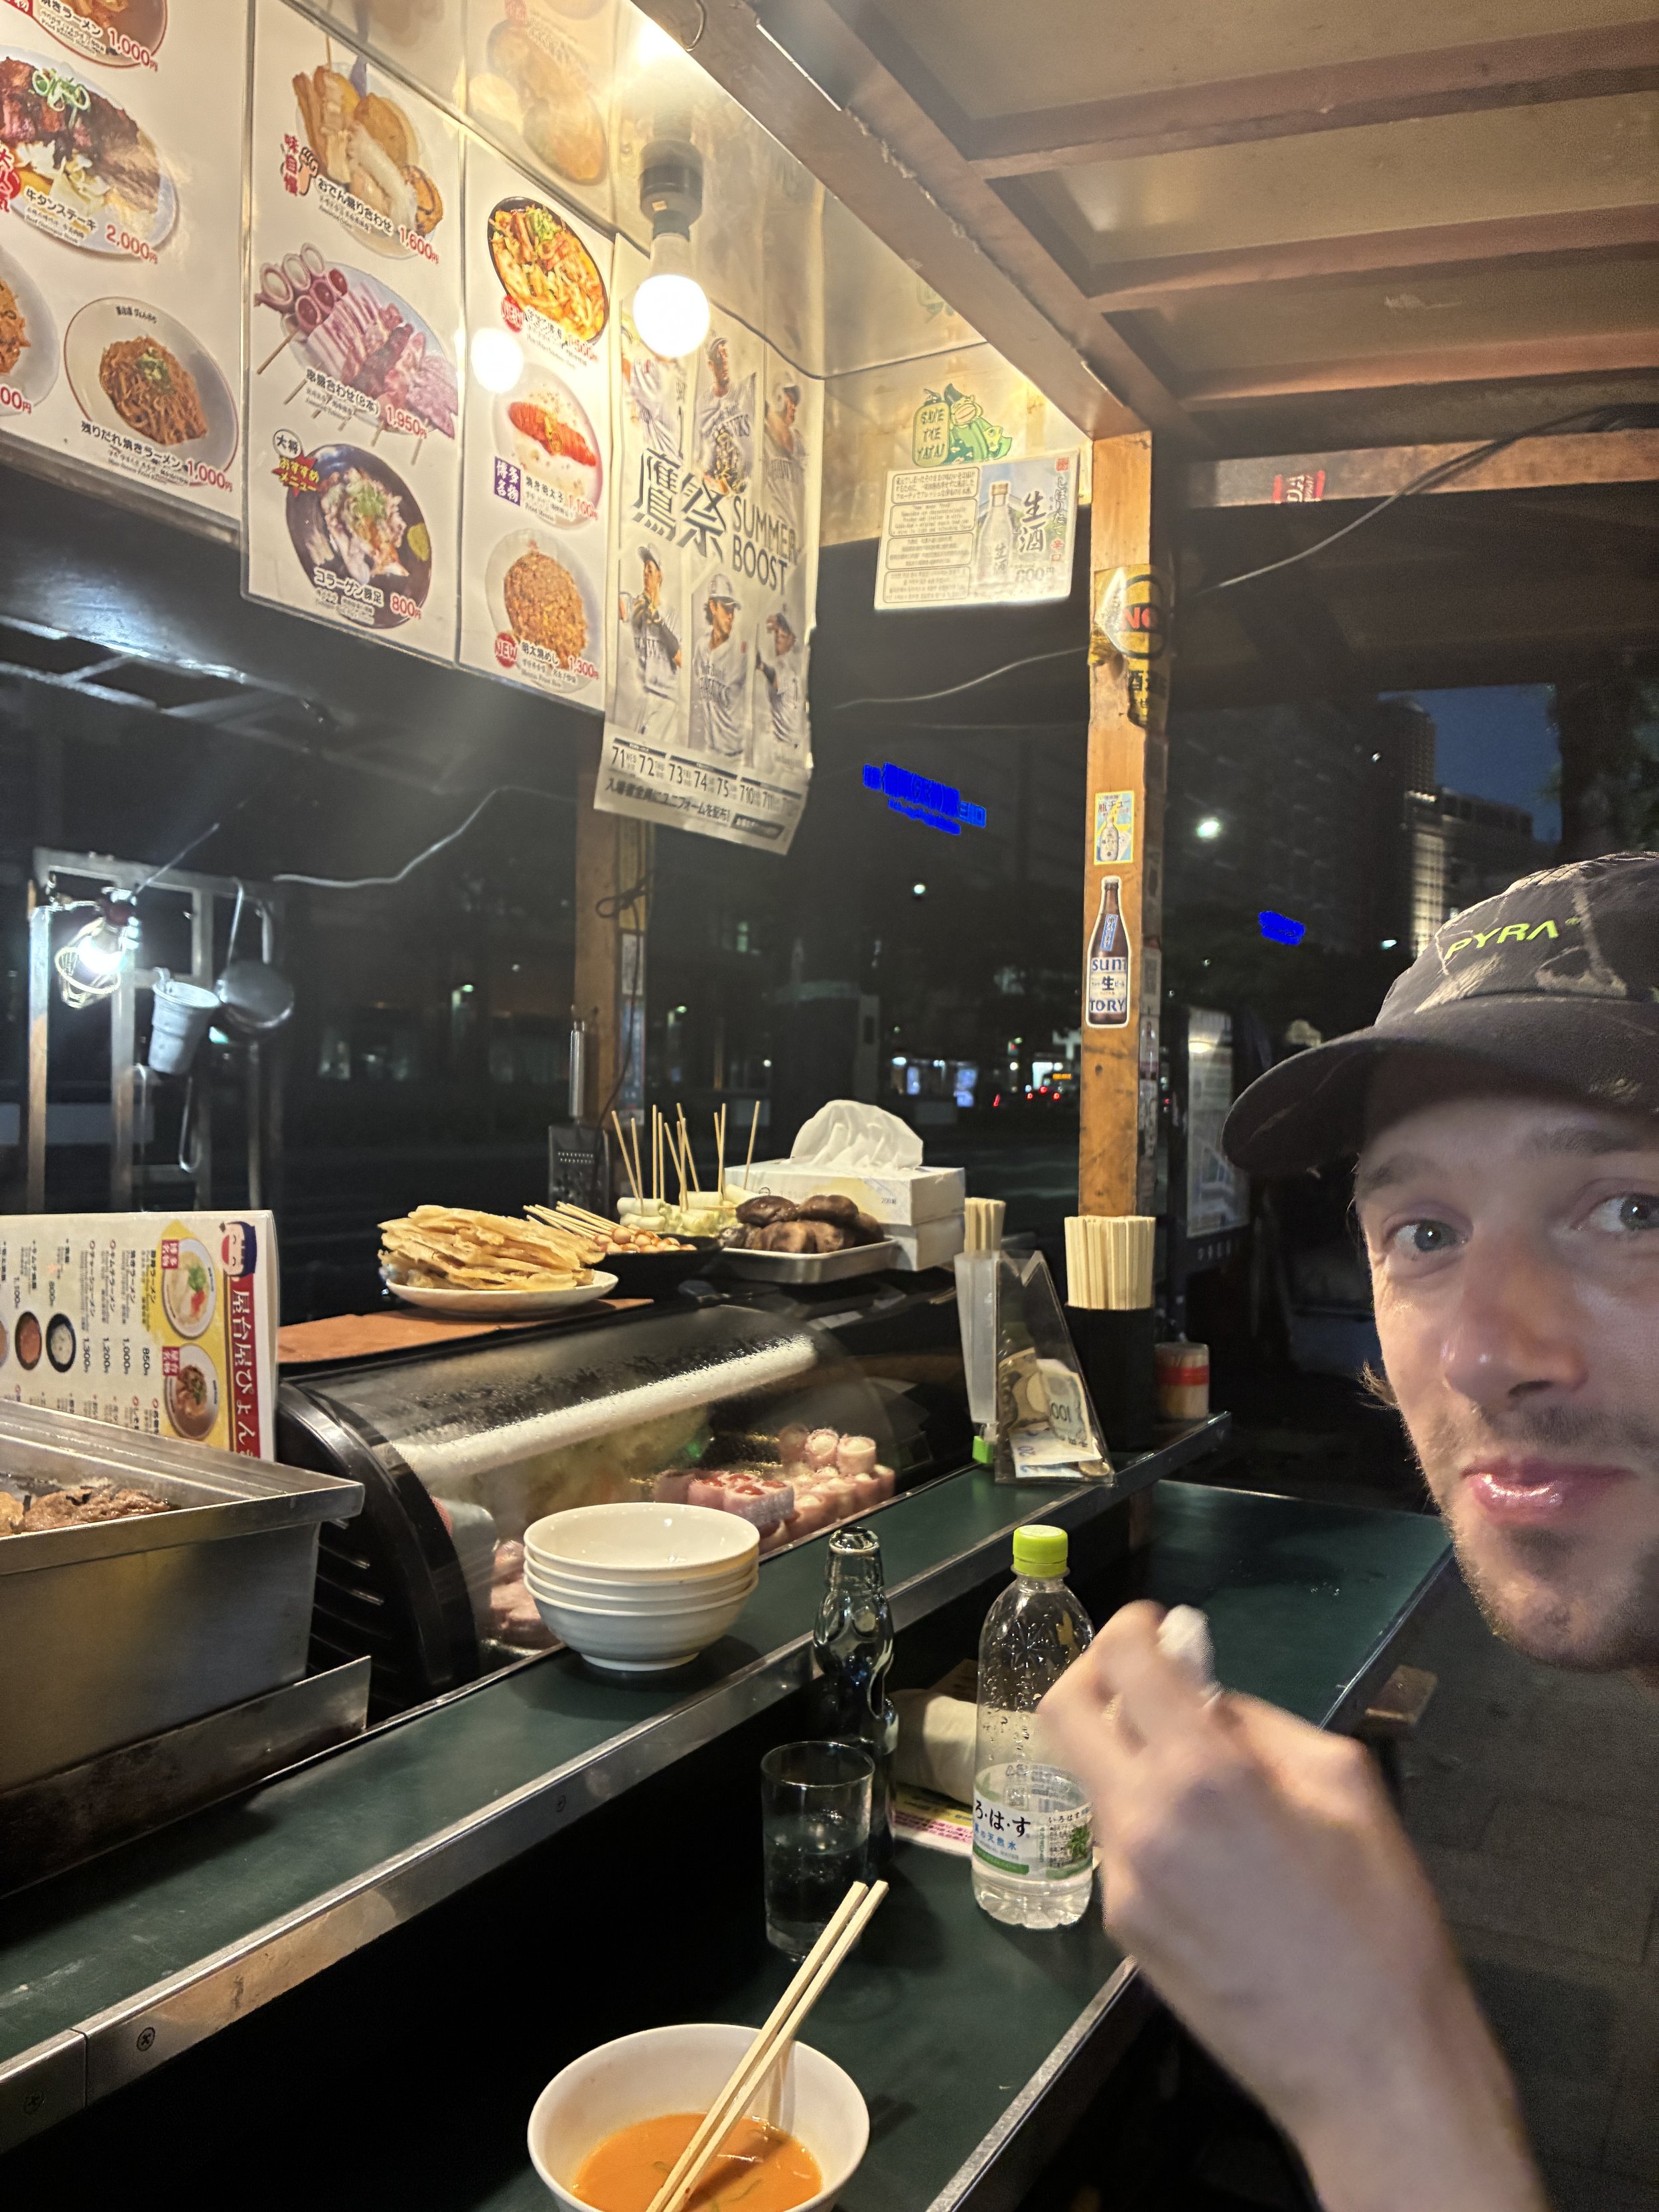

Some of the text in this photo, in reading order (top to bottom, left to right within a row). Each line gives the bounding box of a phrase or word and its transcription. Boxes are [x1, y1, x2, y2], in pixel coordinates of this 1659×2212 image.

[27, 188, 96, 231] 牛タンステーキ
[924, 427, 941, 443] THE
[279, 457, 319, 483] おすすめ
[733, 495, 796, 563] SUMMER
[1019, 490, 1046, 553] 生酒
[733, 534, 788, 595] BOOST
[1102, 975, 1114, 991] 生
[1089, 998, 1125, 1012] TORY
